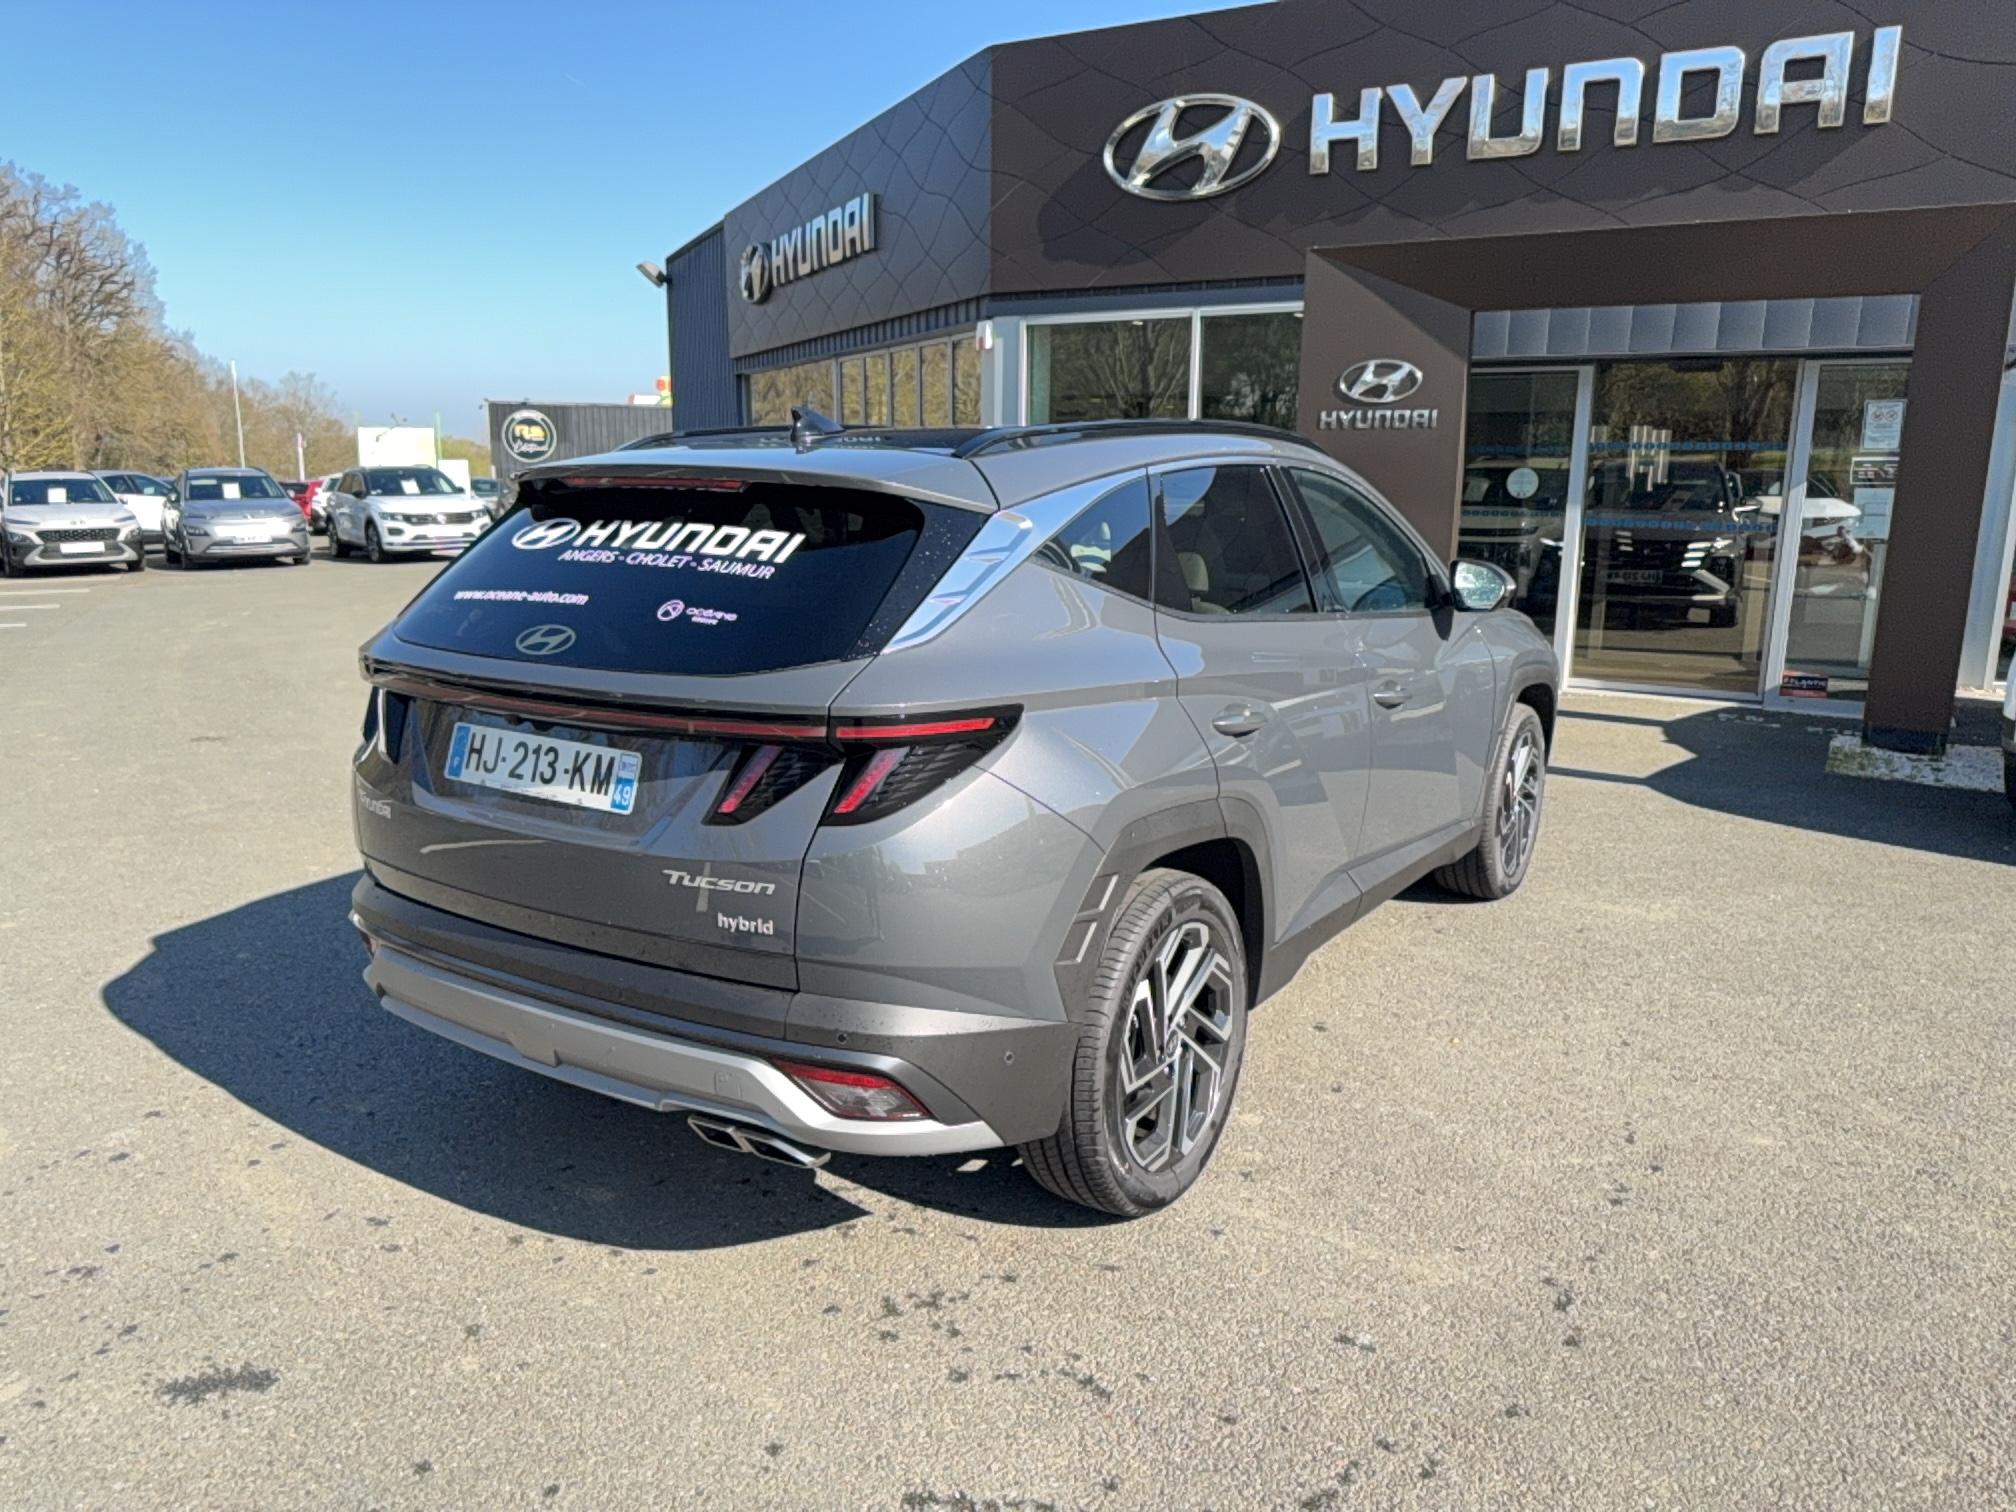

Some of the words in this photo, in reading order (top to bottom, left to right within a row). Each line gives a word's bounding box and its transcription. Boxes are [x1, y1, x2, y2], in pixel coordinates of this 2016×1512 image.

[1309, 25, 1902, 174] HYUNDAI
[771, 191, 872, 288] HYUNDAI
[1319, 408, 1439, 430] HYUNDAI
[572, 520, 807, 563] HYUNDAI
[557, 549, 620, 563] ANGERS
[625, 551, 692, 569] CHOLET
[697, 558, 776, 579] SAUMUR
[465, 732, 615, 797] HJ-213-KM
[717, 911, 774, 936] hybrid
